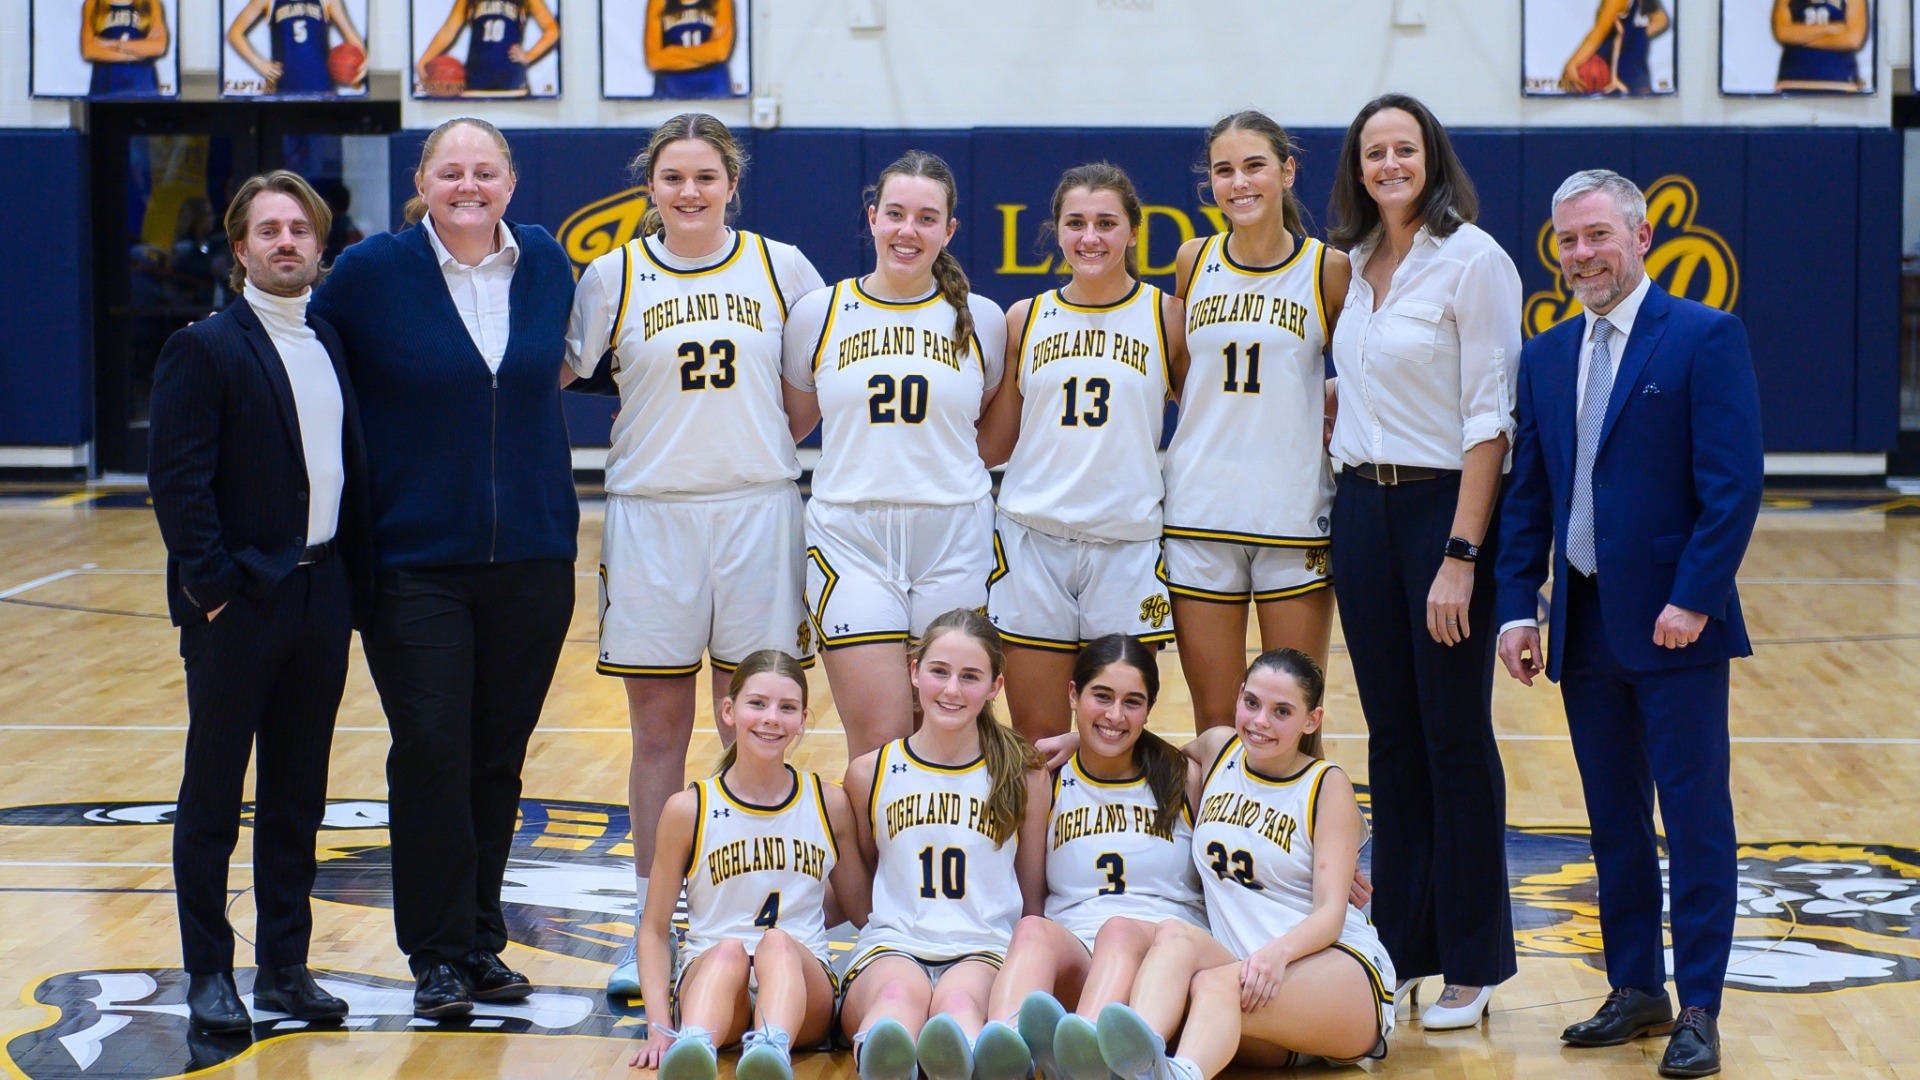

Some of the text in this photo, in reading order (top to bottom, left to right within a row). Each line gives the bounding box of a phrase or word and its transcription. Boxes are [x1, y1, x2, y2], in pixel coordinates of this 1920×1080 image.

[292, 20, 308, 43] 5
[482, 19, 506, 43] 10
[680, 30, 702, 48] 11
[643, 293, 763, 342] HIGHLAND PARK
[1188, 293, 1308, 341] HIGHLAND PARK
[677, 339, 736, 391] 23
[837, 326, 915, 371] HIGHLAND
[1032, 329, 1149, 376] HIGHLAND PARK
[1222, 341, 1261, 394] 11
[867, 373, 929, 425] 20
[1060, 376, 1111, 428] 13
[1139, 593, 1171, 629] HP
[886, 792, 961, 840] HIGHLAND
[1053, 804, 1127, 851] HIGHLAND
[1197, 792, 1297, 855] HIGHLAND PARK
[708, 837, 826, 886] HIGHLAND PARK
[918, 845, 967, 900] 10
[1096, 851, 1126, 896] 3
[753, 890, 781, 931] 4
